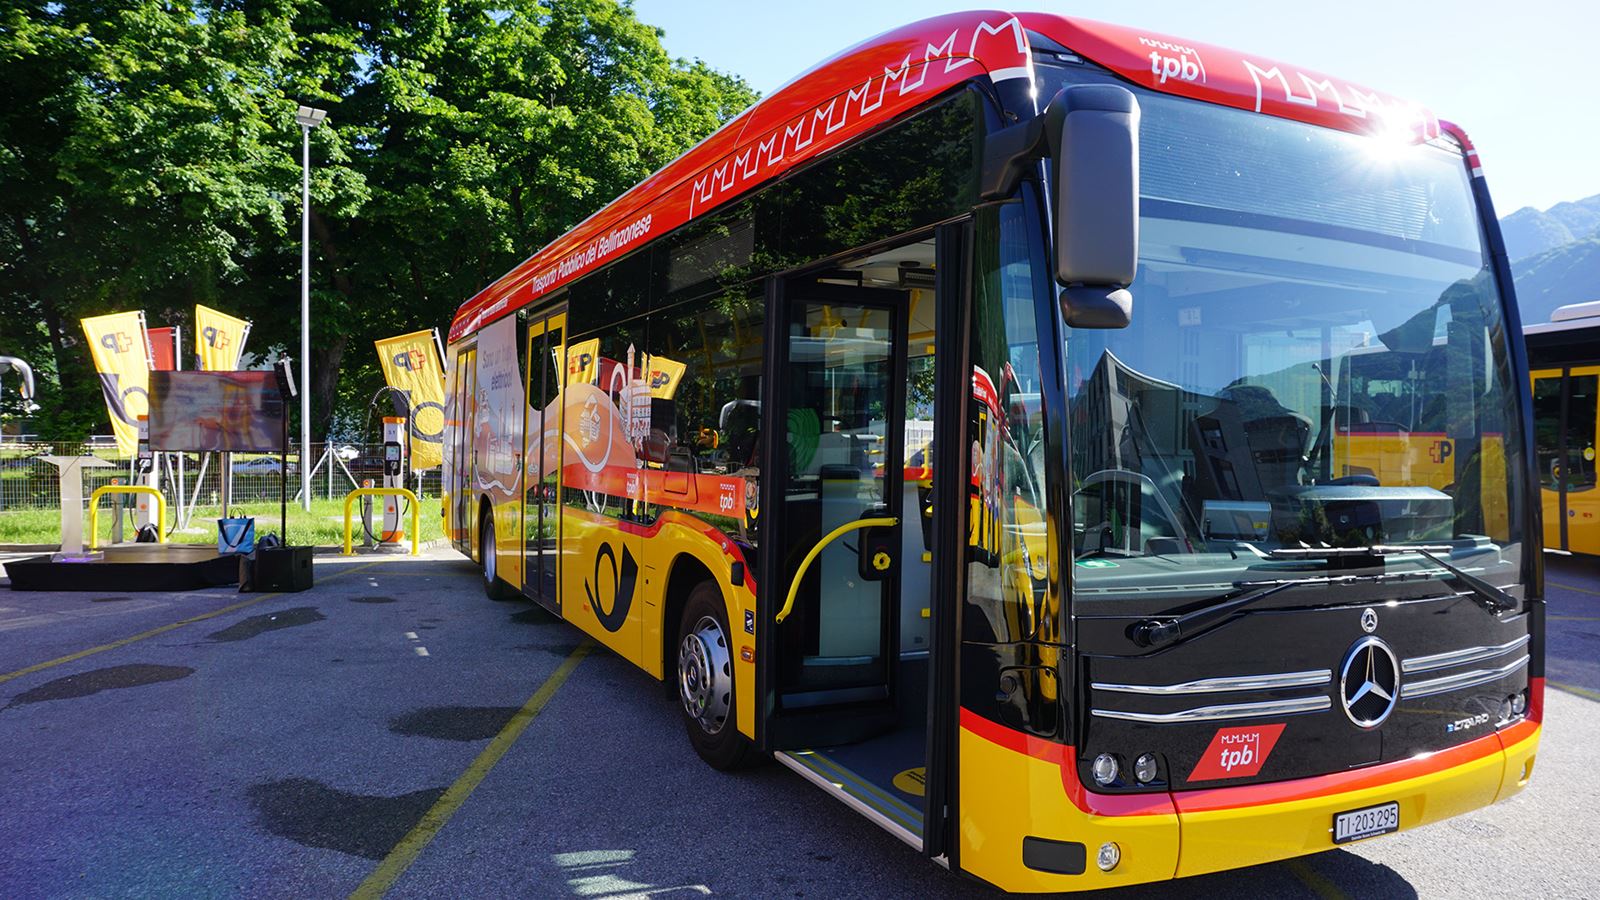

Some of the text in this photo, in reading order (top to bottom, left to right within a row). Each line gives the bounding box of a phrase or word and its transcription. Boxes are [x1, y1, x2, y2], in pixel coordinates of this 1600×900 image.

[1149, 51, 1199, 83] tpb
[532, 214, 652, 293] Trasporto Pubblico del Bellinzonese
[720, 492, 733, 511] tpb
[1221, 745, 1253, 771] tpb
